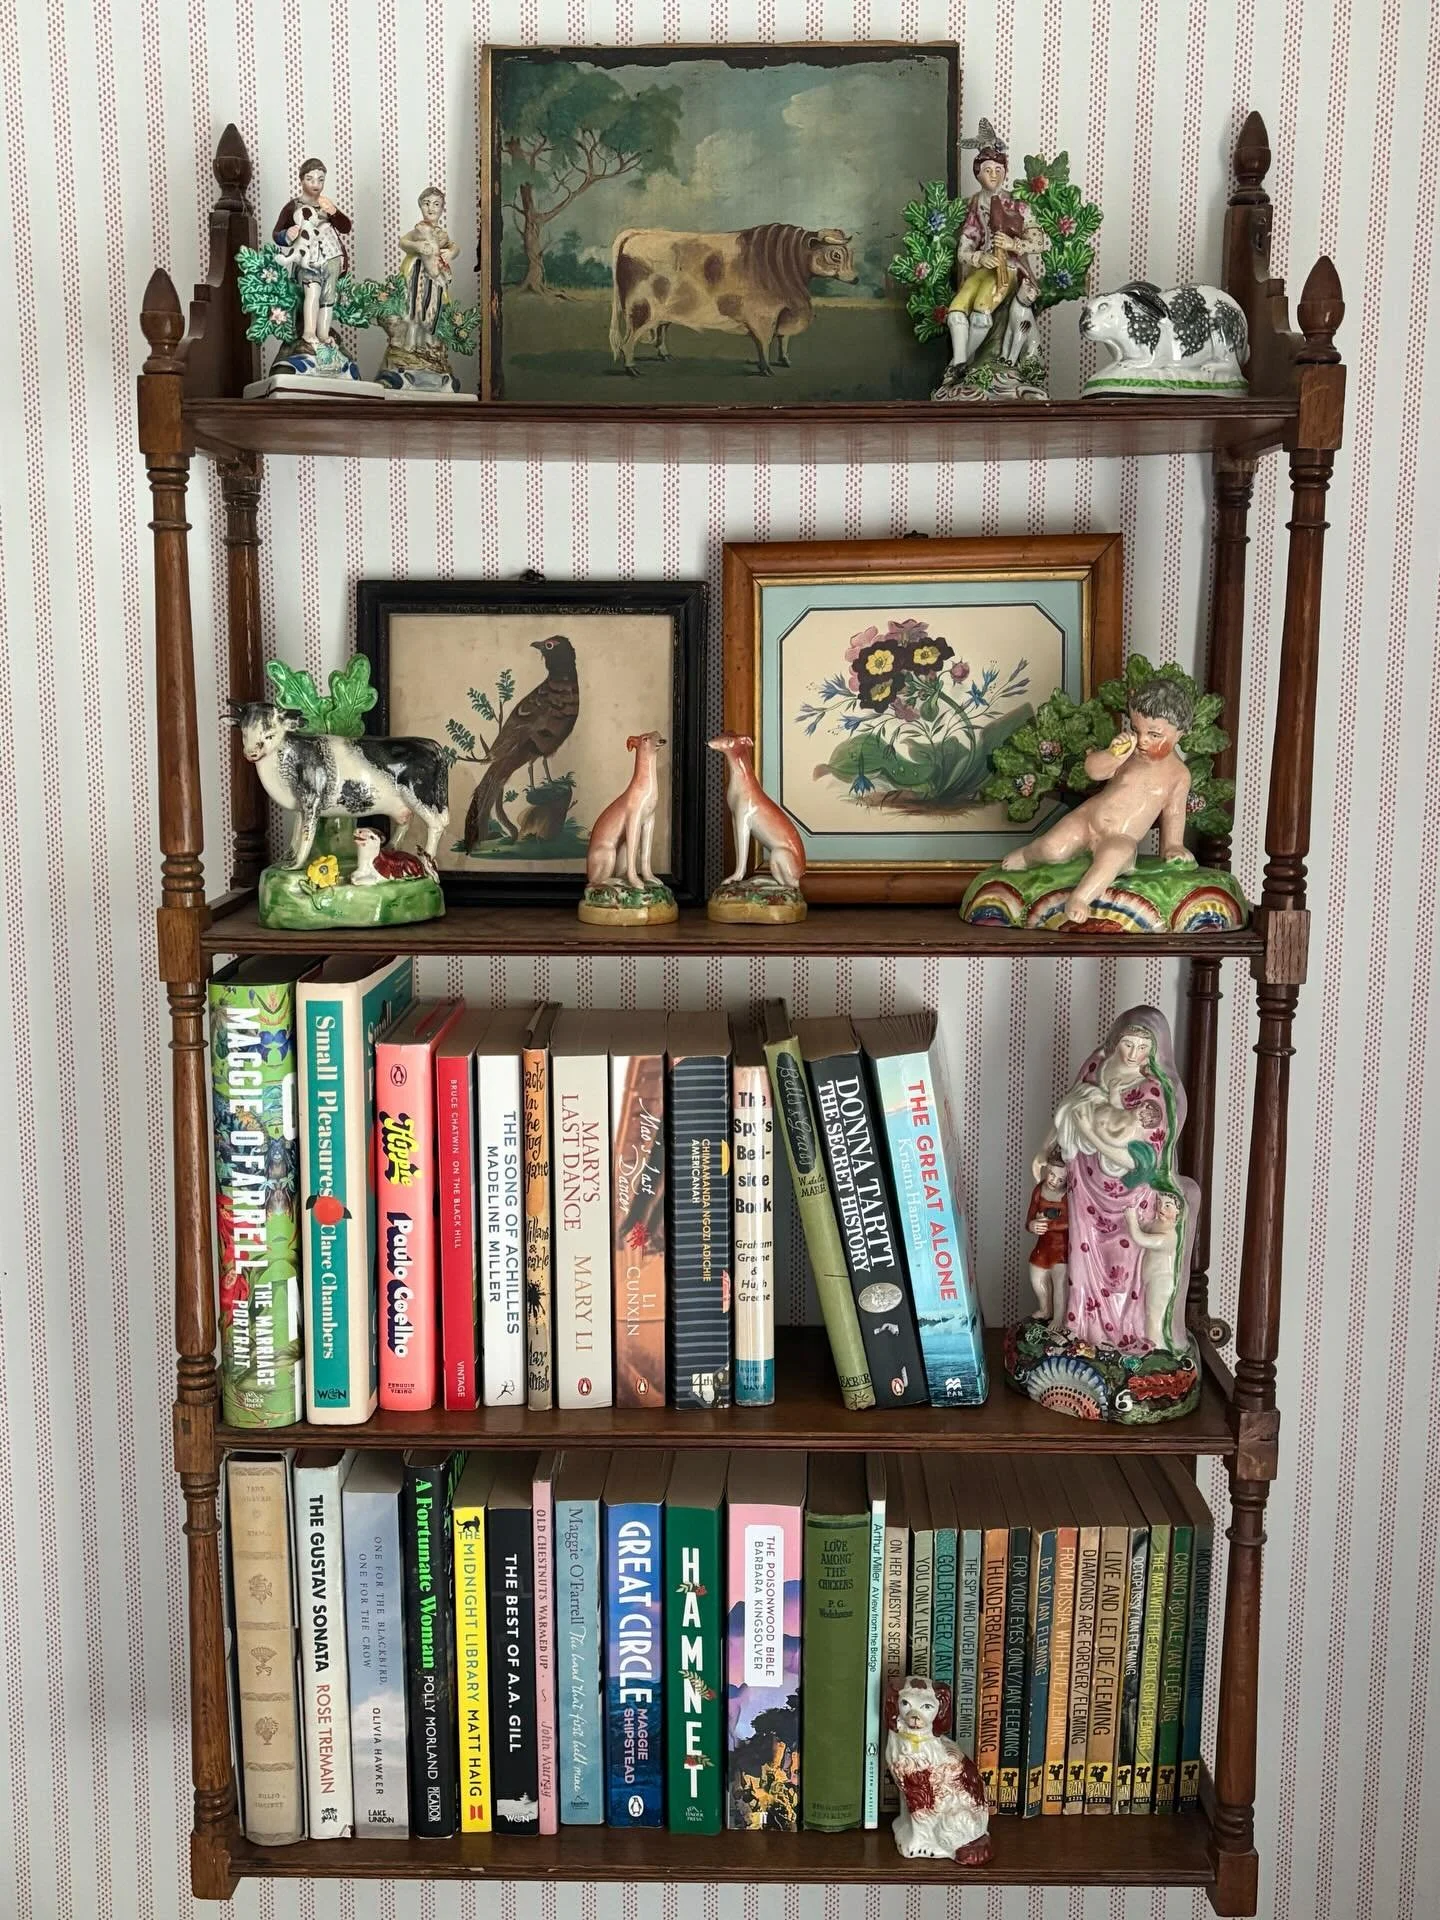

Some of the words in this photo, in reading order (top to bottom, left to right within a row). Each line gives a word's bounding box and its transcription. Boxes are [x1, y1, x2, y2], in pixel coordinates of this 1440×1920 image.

[226, 1007, 264, 1114] MAGGIE
[315, 1015, 338, 1081] Small
[450, 1079, 458, 1108] BRUCE
[818, 1080, 839, 1122] THE
[908, 1080, 930, 1127] THE
[451, 1113, 459, 1154] CHATWIN
[503, 1111, 517, 1147] THE
[561, 1094, 579, 1144] LAST
[639, 1098, 661, 1154] Mao's
[317, 1090, 339, 1197] Pleasures
[381, 1113, 424, 1188] Hippie
[581, 1121, 600, 1203] MARY'S
[826, 1121, 854, 1195] SECRET
[452, 1161, 460, 1175] ON
[504, 1154, 518, 1207] SONG
[635, 1157, 661, 1195] Last
[691, 1139, 701, 1204] AMERICANAH
[701, 1138, 711, 1208] CHIMAMANDA
[835, 1076, 873, 1177] DONNA
[857, 1177, 896, 1268] TARTT
[898, 1138, 917, 1190] Kristin
[916, 1136, 944, 1212] GREAT
[453, 1178, 461, 1194] THE
[487, 1146, 500, 1233] MADELINE
[562, 1155, 582, 1231] DANCE
[453, 1198, 462, 1227] BLACK
[505, 1214, 518, 1238] OF
[702, 1211, 712, 1241] NGOZI
[906, 1191, 927, 1249] Hannah
[321, 1224, 337, 1268] Clare
[392, 1218, 414, 1280] Paulo
[454, 1230, 463, 1249] HILL
[839, 1195, 871, 1272] HISTORY
[488, 1240, 501, 1302] MILLER
[702, 1244, 712, 1282] ADICHIE
[930, 1221, 958, 1301] ALONE
[254, 1282, 272, 1308] THE
[505, 1245, 520, 1334] ACHILLES
[574, 1255, 593, 1323] MARY
[626, 1266, 641, 1336] CUNXIN
[642, 1294, 656, 1308] LI
[232, 1300, 250, 1368] PORTRAIT
[321, 1272, 339, 1359] Chambers
[392, 1286, 414, 1358] Coelho
[255, 1316, 275, 1386] MARRIAGE
[575, 1331, 593, 1352] LI
[456, 1361, 465, 1398] VINTAGE
[416, 1478, 433, 1493] A
[309, 1495, 324, 1526] THE
[536, 1509, 546, 1532] OLD
[374, 1537, 383, 1560] ONE
[416, 1497, 433, 1592] Fortunate
[458, 1531, 481, 1540] THE
[564, 1507, 583, 1560] Maggie
[766, 1536, 775, 1557] THE
[824, 1540, 849, 1552] LOVE
[873, 1523, 884, 1552] Arthur
[889, 1539, 903, 1552] ON
[310, 1532, 327, 1599] GUSTAV
[359, 1553, 368, 1577] ONE
[375, 1567, 384, 1588] FOR
[504, 1553, 518, 1589] THE
[537, 1536, 548, 1600] CHESTNUTS
[618, 1521, 652, 1607] GREAT
[754, 1541, 763, 1594] BARBARA
[820, 1553, 852, 1565] AMONG
[825, 1566, 847, 1577] THE
[872, 1555, 883, 1583] Miller
[888, 1557, 902, 1575] HER
[915, 1556, 929, 1580] YOU
[962, 1557, 977, 1575] THE
[1011, 1555, 1028, 1576] FOR
[1039, 1556, 1052, 1573] Dr.
[1058, 1547, 1076, 1579] FROM
[1102, 1551, 1123, 1578] LIVE
[359, 1583, 369, 1604] FOR
[463, 1544, 478, 1628] MIDNIGHT
[568, 1564, 584, 1626] O'Farrell
[818, 1579, 854, 1591] CHICKENS
[962, 1579, 976, 1595] SPY
[1010, 1582, 1027, 1612] YOUR
[1078, 1549, 1098, 1610] DIAMONDS
[1100, 1584, 1121, 1611] AND
[360, 1609, 370, 1631] THE
[376, 1593, 385, 1614] THE
[505, 1596, 519, 1638] BEST
[765, 1562, 776, 1642] POISONWOOD
[887, 1580, 902, 1628] MAJESTY'S
[914, 1587, 928, 1614] ONLY
[961, 1601, 975, 1622] WHO
[312, 1605, 329, 1672] SONATA
[419, 1595, 437, 1669] Woman
[537, 1603, 549, 1651] WARMED
[753, 1600, 763, 1670] KINGSOLVER
[870, 1613, 880, 1634] from
[914, 1620, 928, 1641] LIVE
[960, 1625, 975, 1654] LOVED
[1008, 1617, 1025, 1643] EYES
[1076, 1615, 1093, 1636] ARE
[1098, 1617, 1119, 1641] LET
[362, 1638, 371, 1668] CROW
[377, 1622, 388, 1685] BLACKBIRD,
[465, 1634, 480, 1702] LIBRARY
[507, 1644, 520, 1667] OF
[539, 1655, 549, 1669] UP
[619, 1614, 653, 1703] CIRCLE
[765, 1646, 775, 1676] BIBLE
[868, 1647, 880, 1673] Bridge
[886, 1632, 900, 1665] SECRET
[1034, 1626, 1049, 1676] FLEMING
[316, 1684, 332, 1724] ROSE
[423, 1676, 435, 1713] POLLY
[372, 1707, 382, 1745] OLIVIA
[467, 1709, 481, 1753] MATT
[508, 1714, 521, 1753] GILL
[541, 1721, 553, 1751] John
[637, 1708, 649, 1761] MAGGIE
[958, 1698, 972, 1737] FLEMING
[980, 1695, 999, 1752] FLEMING
[1002, 1708, 1020, 1756] FLEMING
[318, 1728, 335, 1794] TREMAIN
[424, 1717, 438, 1780] MORLAND
[623, 1708, 636, 1784] SHIPSTEAD
[374, 1748, 384, 1795] HAWKER
[468, 1757, 482, 1797] HAIG
[540, 1754, 553, 1798] Murray
[368, 1809, 387, 1817] LAKE
[427, 1786, 441, 1822] PICADOR
